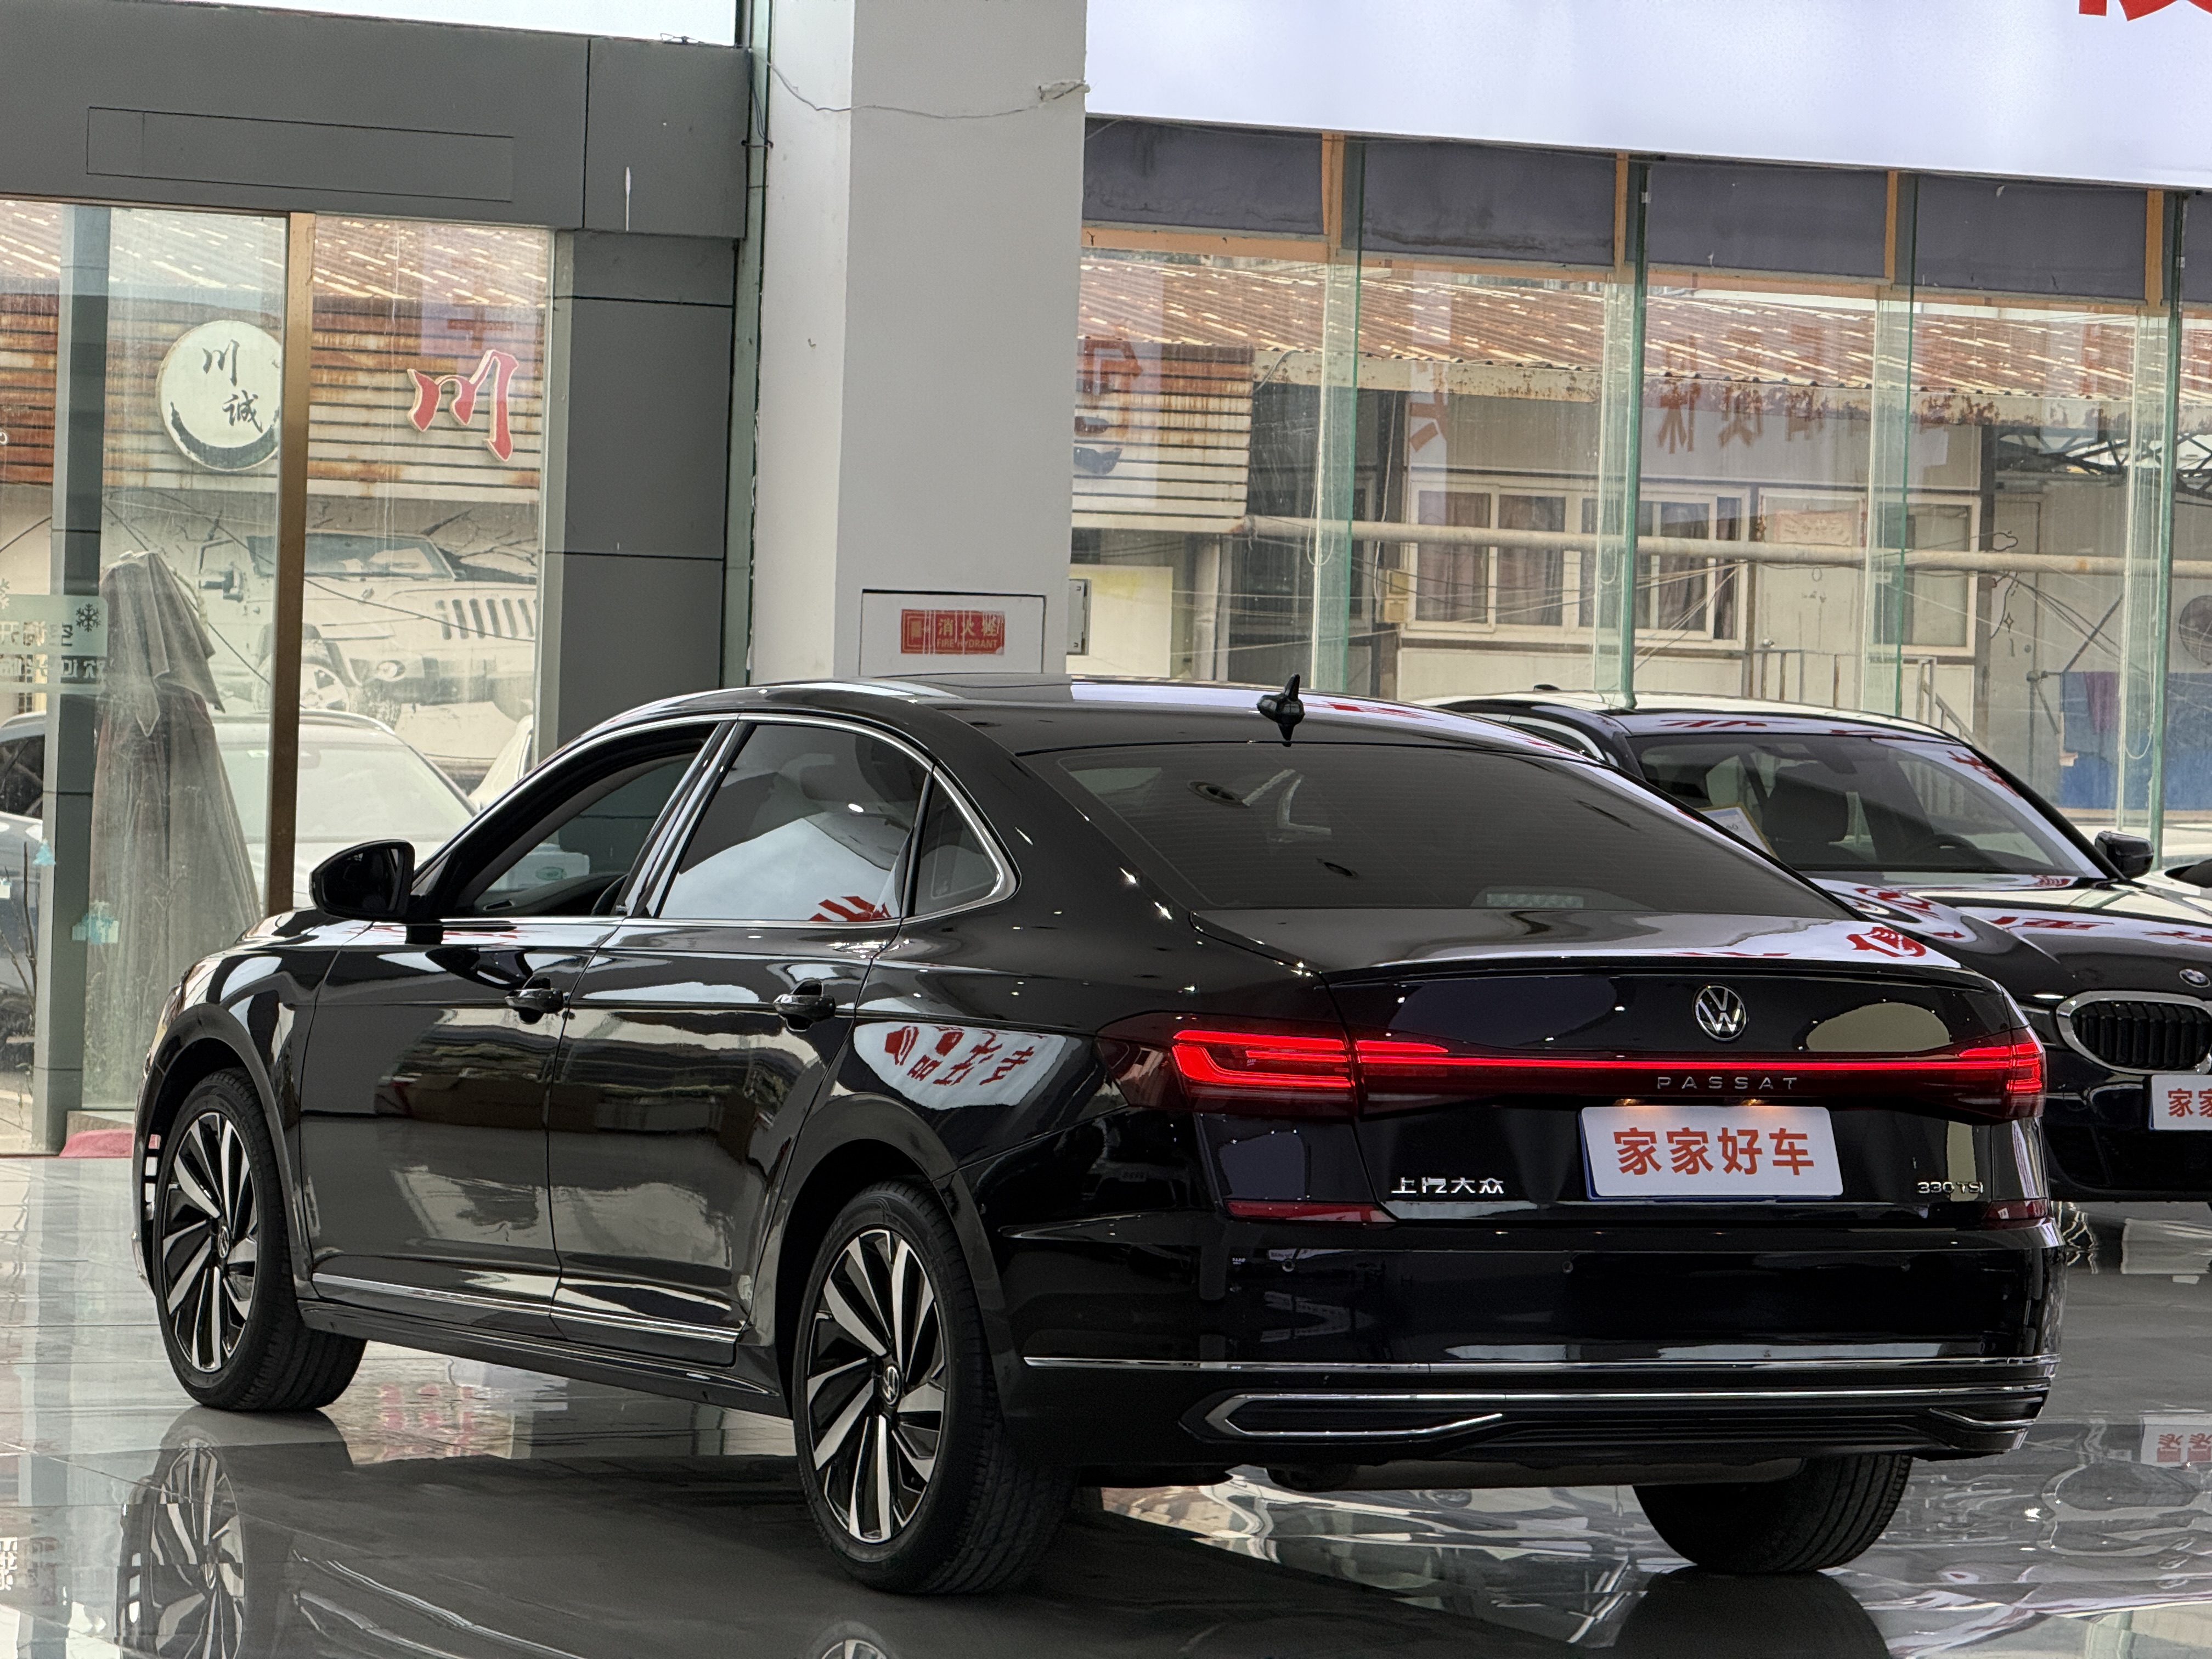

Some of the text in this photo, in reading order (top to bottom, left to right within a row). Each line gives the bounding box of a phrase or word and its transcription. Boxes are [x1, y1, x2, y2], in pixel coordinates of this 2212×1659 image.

[937, 618, 997, 636] 消火栓
[937, 639, 998, 648] FIRE HYDRANT
[1656, 1076, 1798, 1090] PASSAT
[1613, 1127, 1814, 1176] 家家好车
[1391, 1177, 1504, 1194] 上汽大众
[1917, 1181, 1984, 1194] 330 TSI
